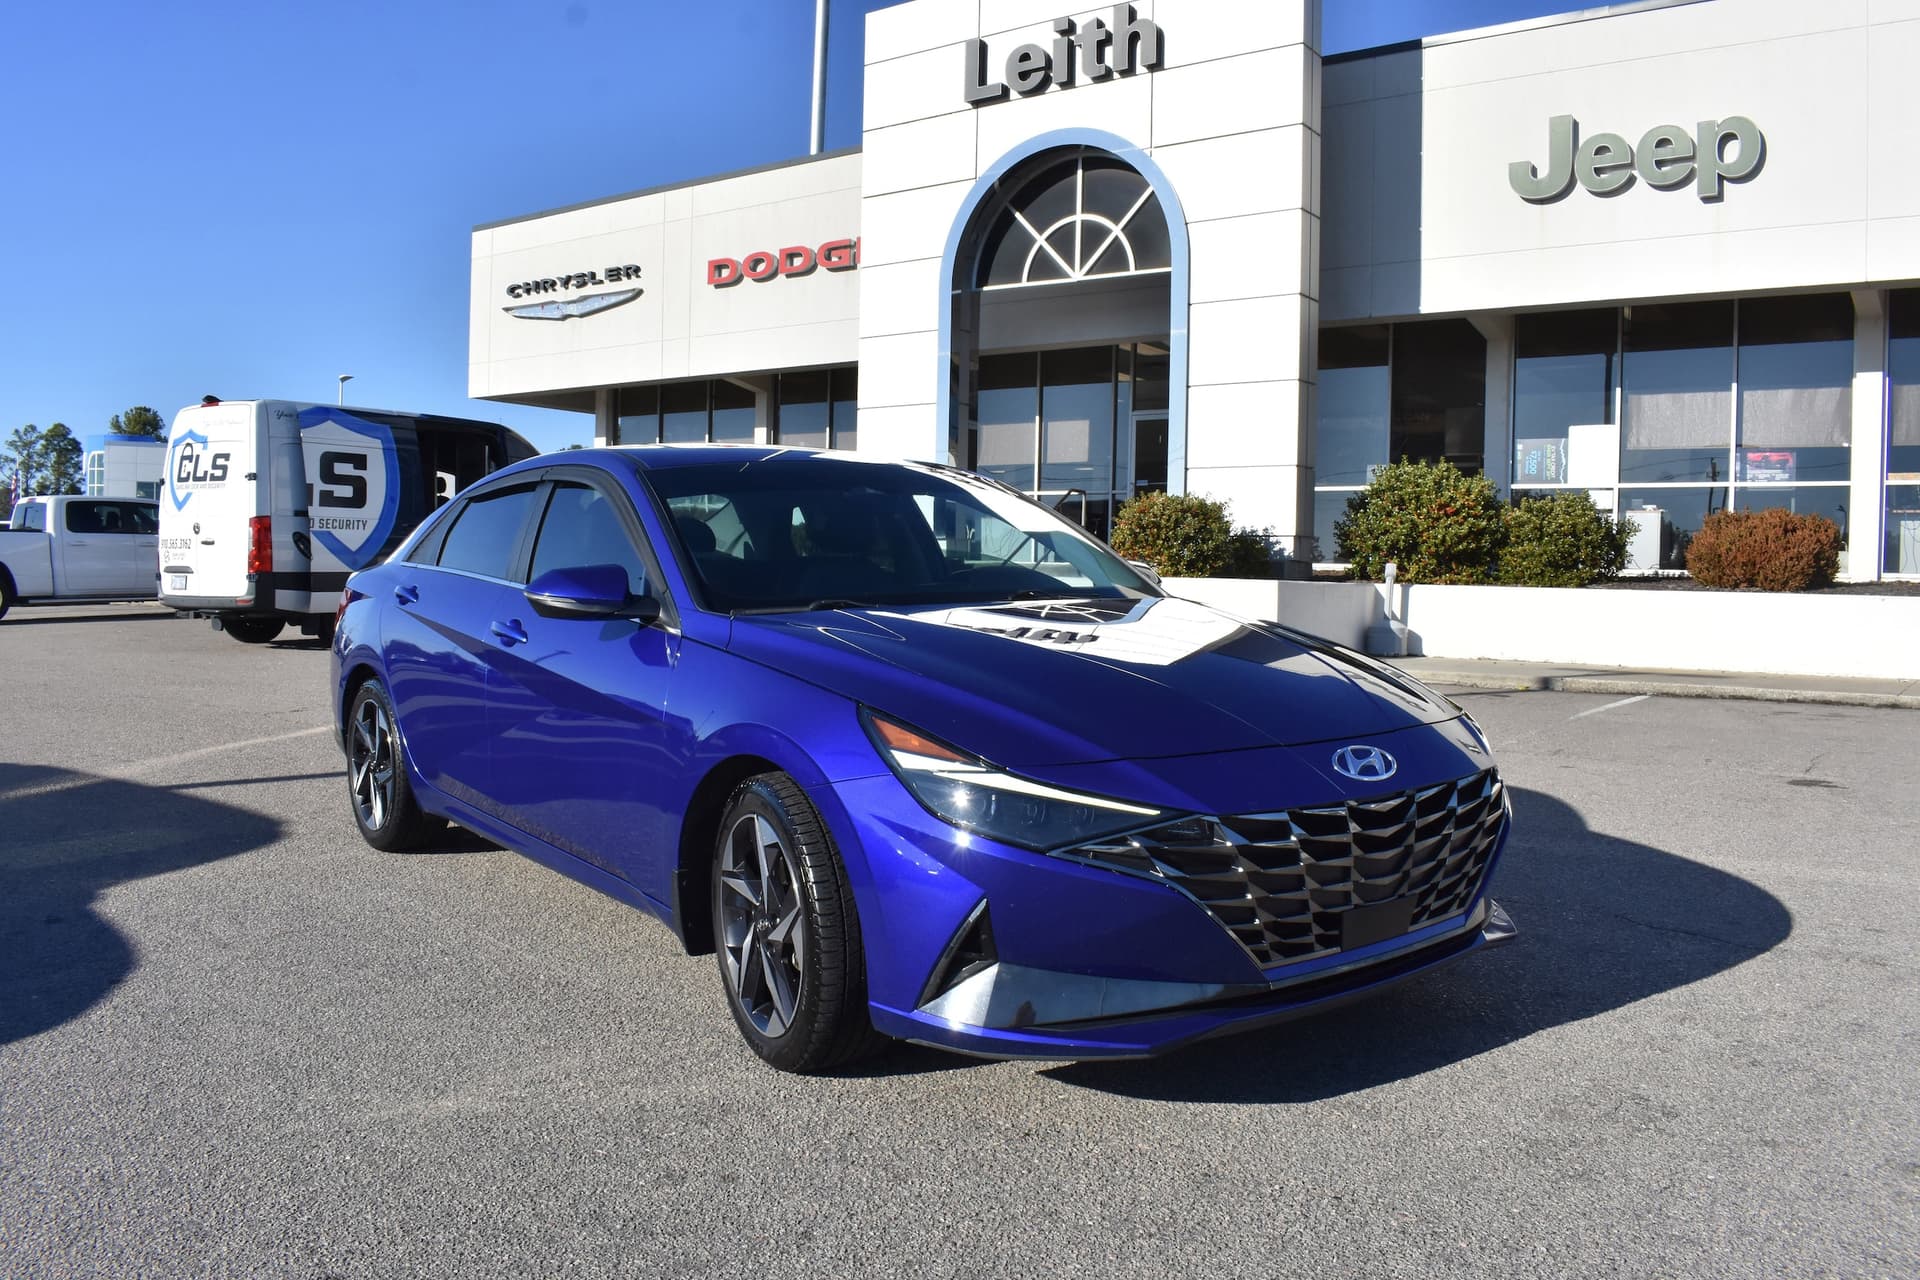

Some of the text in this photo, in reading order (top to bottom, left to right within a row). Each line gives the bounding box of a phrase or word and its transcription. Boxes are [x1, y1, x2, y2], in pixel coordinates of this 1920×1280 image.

[964, 3, 1165, 107] Leith
[1508, 114, 1767, 204] Jeep
[506, 264, 641, 298] CHRYSLER
[707, 237, 861, 289] DODG
[177, 451, 231, 482] CLS
[306, 451, 367, 509] S
[319, 518, 368, 531] SECURITY
